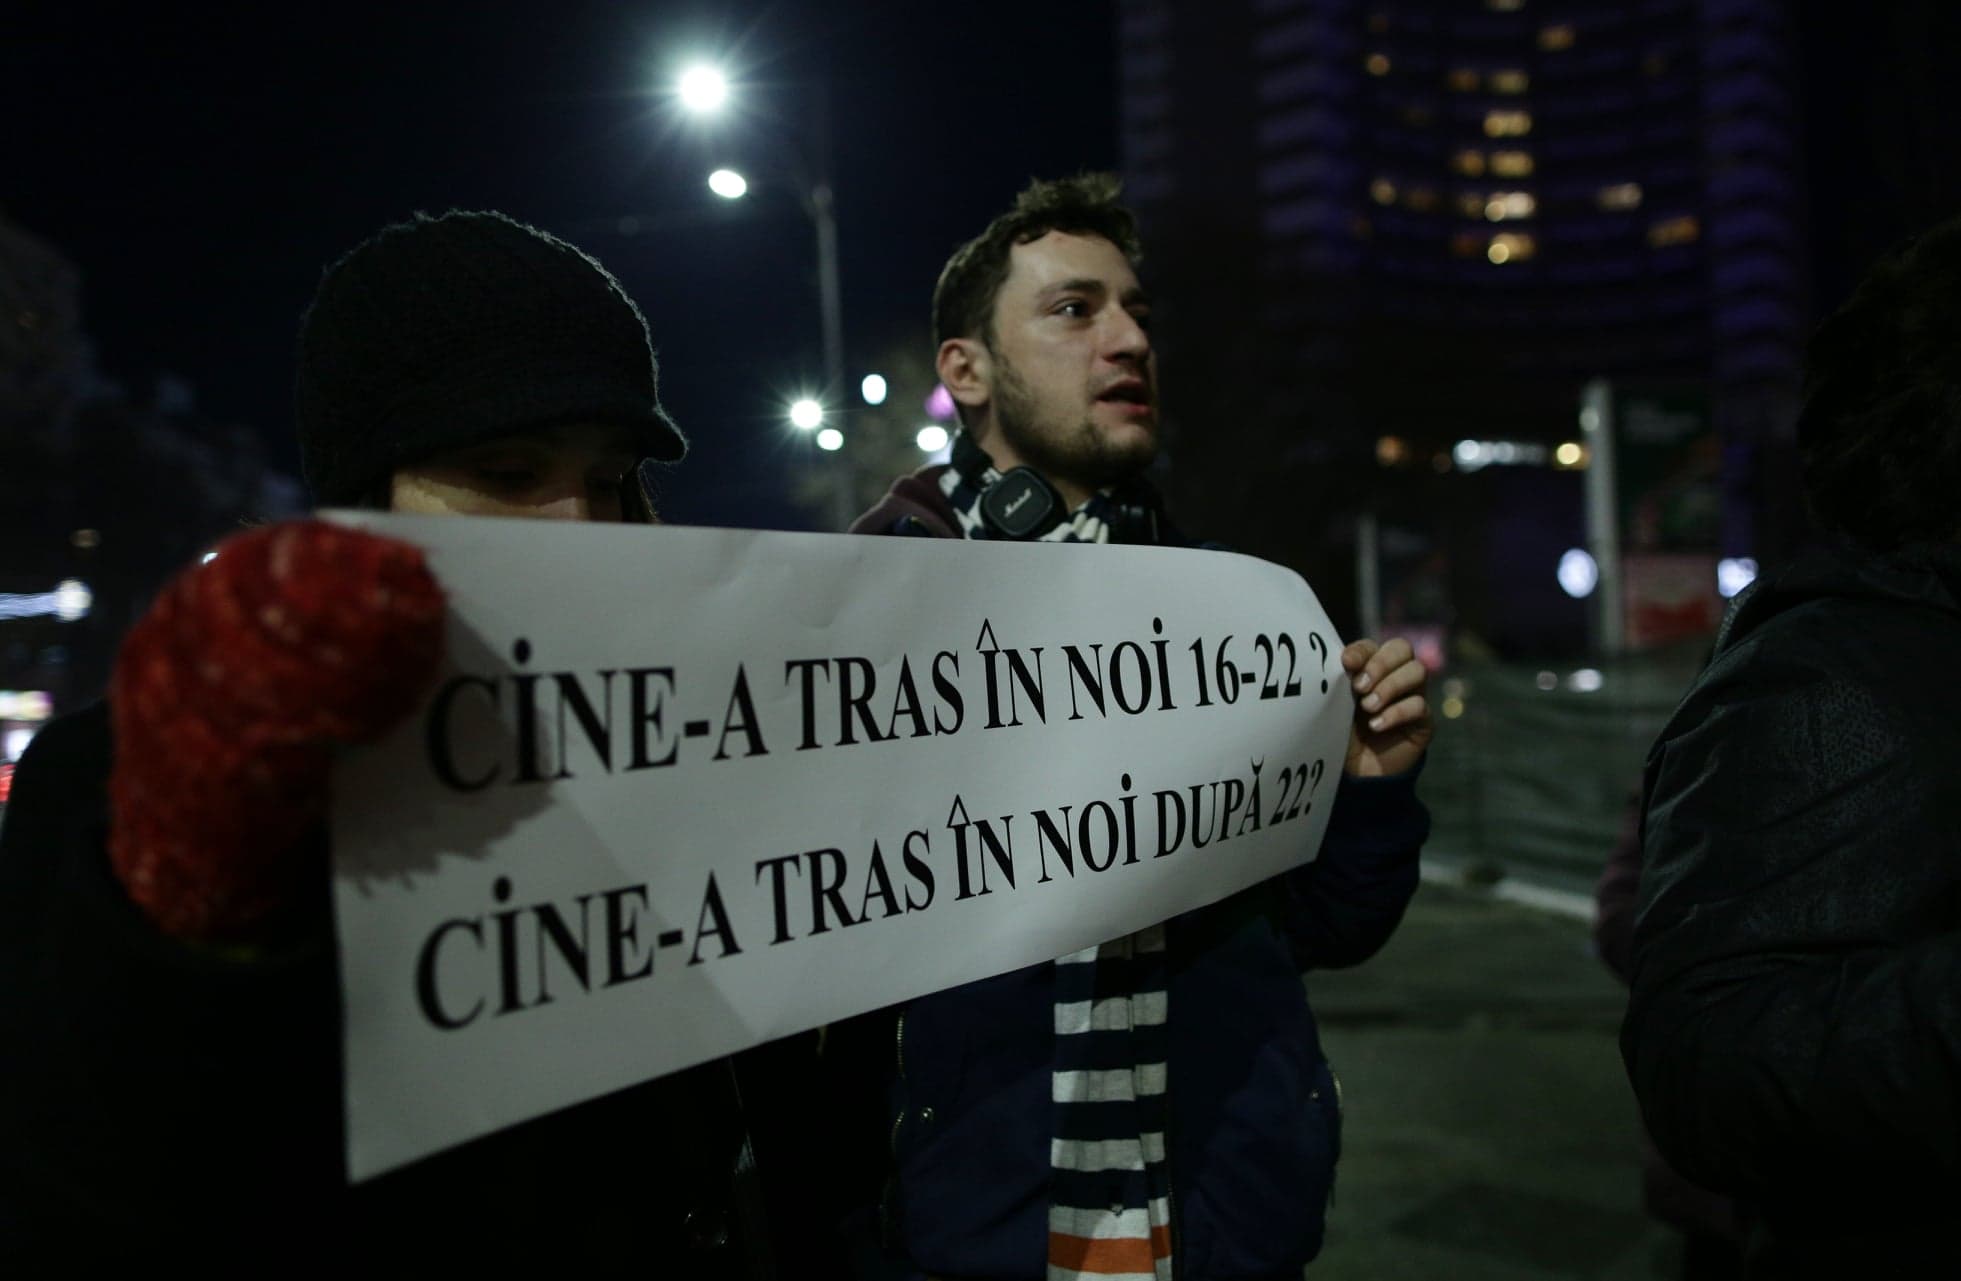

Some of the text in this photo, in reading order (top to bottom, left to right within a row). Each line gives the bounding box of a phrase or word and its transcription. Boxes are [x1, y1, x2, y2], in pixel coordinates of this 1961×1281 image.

[785, 651, 965, 752] TRAS
[975, 617, 1047, 737] ÎN
[1189, 632, 1302, 708] 16-22
[1307, 631, 1330, 697] ?
[755, 829, 937, 946] TRAS
[946, 793, 1017, 902] ÎN
[1152, 757, 1267, 860] DUPĂ
[1267, 758, 1326, 830] 22?
